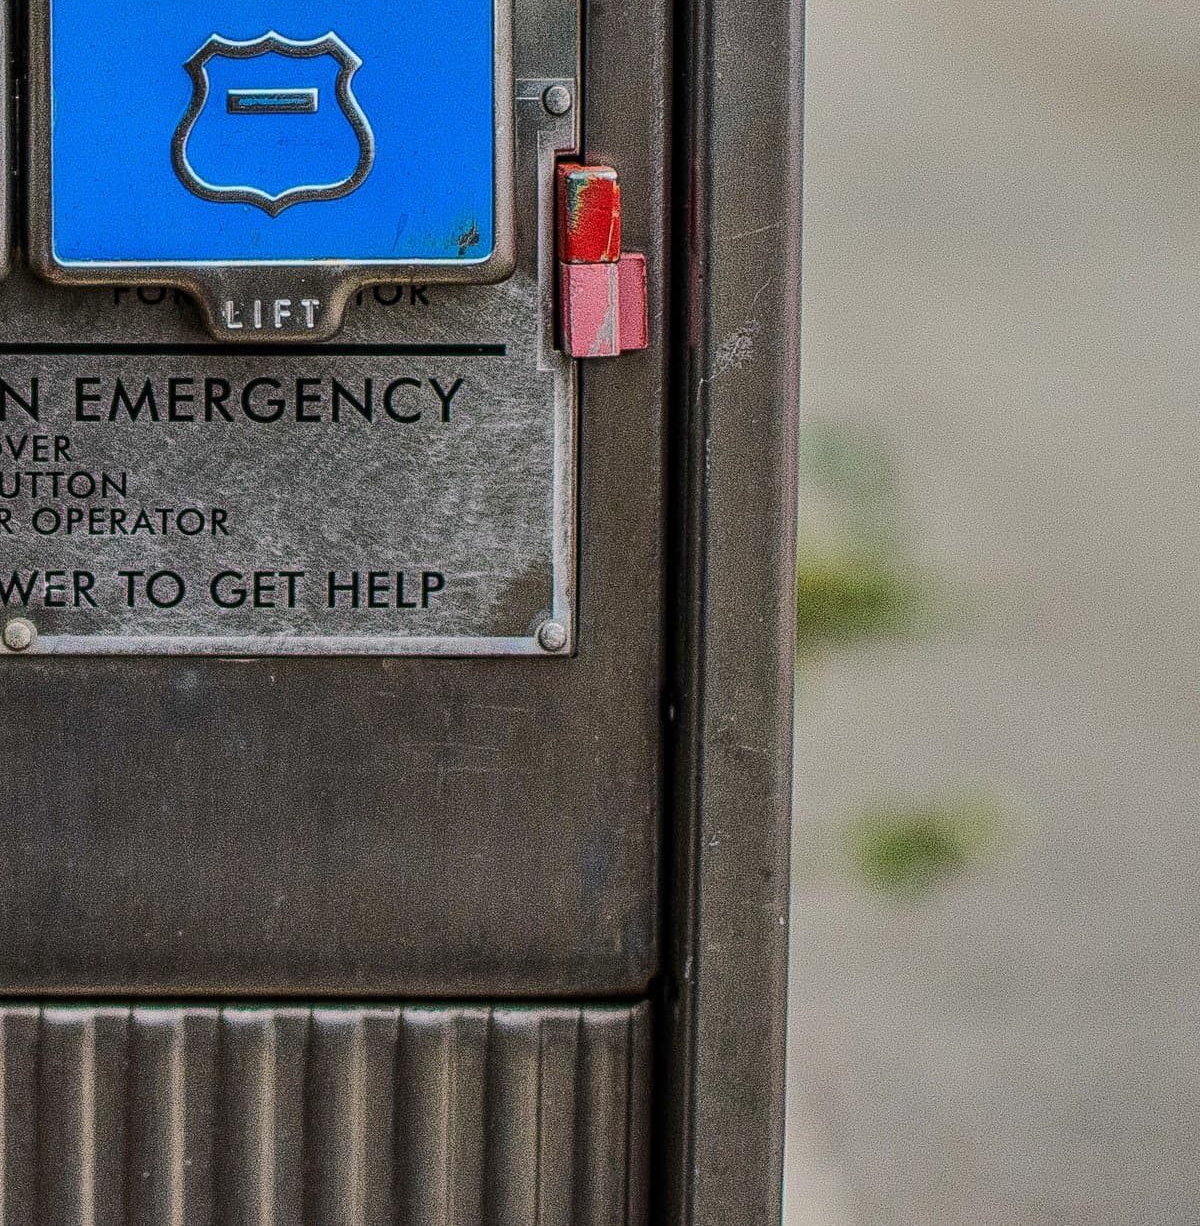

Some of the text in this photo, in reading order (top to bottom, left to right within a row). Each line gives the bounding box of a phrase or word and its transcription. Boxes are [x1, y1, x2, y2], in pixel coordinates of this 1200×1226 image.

[224, 299, 321, 330] LIFT
[75, 377, 465, 424] EMERGENCY
[32, 507, 230, 536] OPERATOR
[118, 570, 186, 609] TO
[210, 570, 306, 609] GET
[328, 571, 446, 609] HELP
